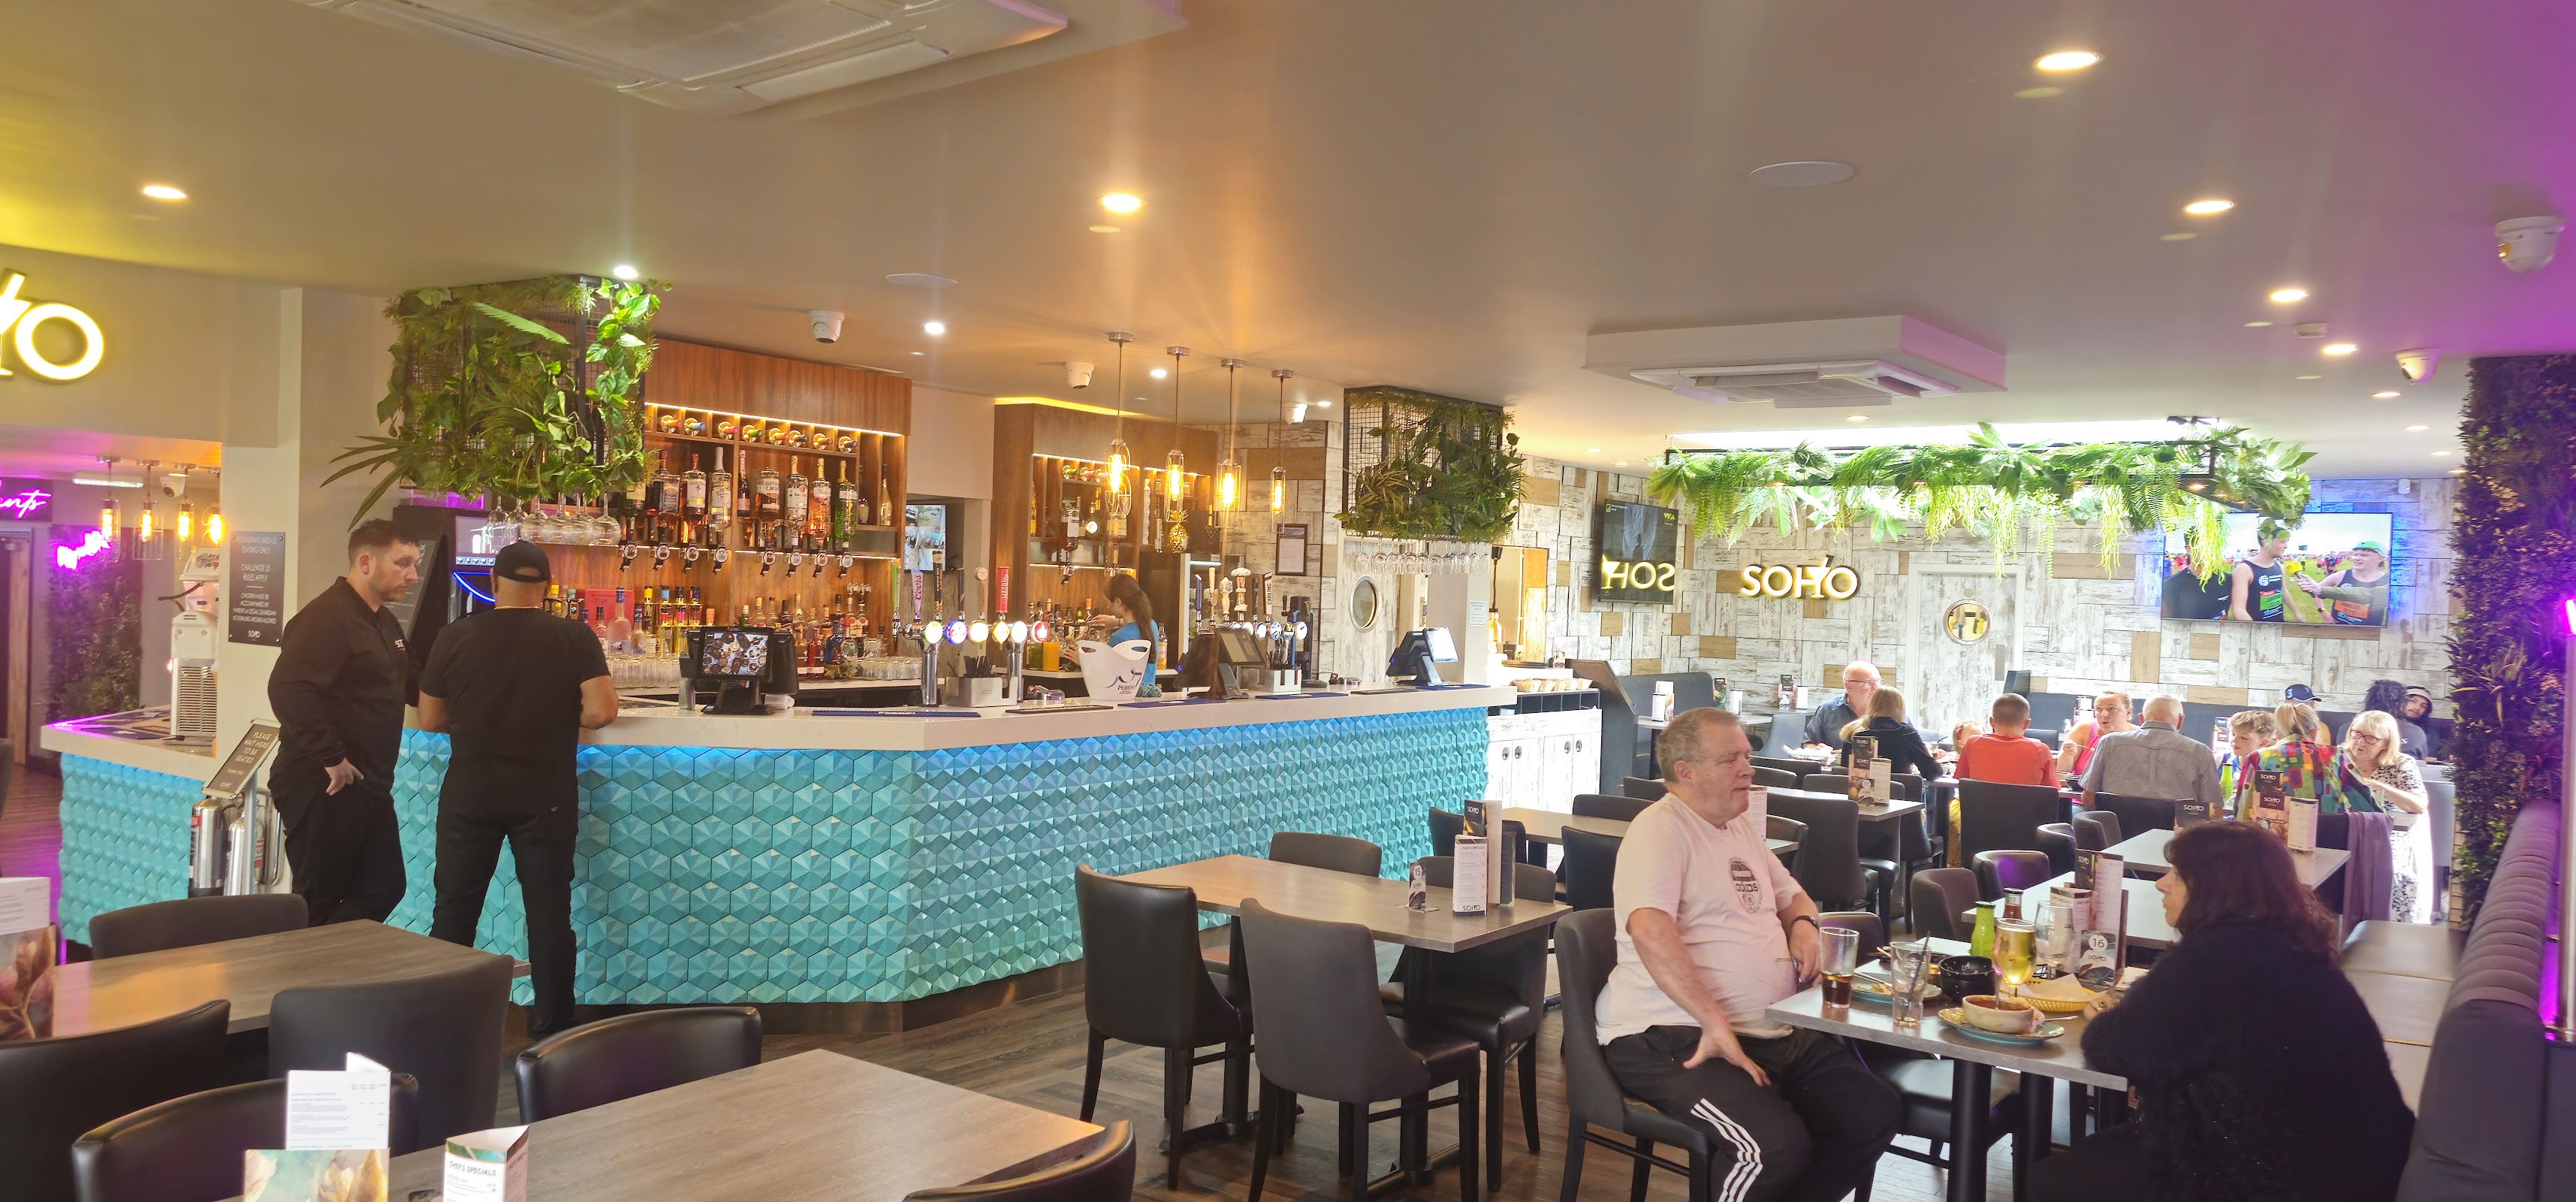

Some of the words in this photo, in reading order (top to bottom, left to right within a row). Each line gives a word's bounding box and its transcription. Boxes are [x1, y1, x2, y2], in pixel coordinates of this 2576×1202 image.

[1740, 556, 1859, 600] SOHO
[248, 630, 261, 639] SOHO
[2287, 688, 2293, 699] 3
[253, 732, 273, 740] PLEASE
[255, 740, 270, 749] HERE
[235, 755, 255, 763] SEATED
[1467, 806, 1480, 814] SOHO
[2092, 938, 2104, 948] 16
[466, 1166, 496, 1176] SPECIALS
